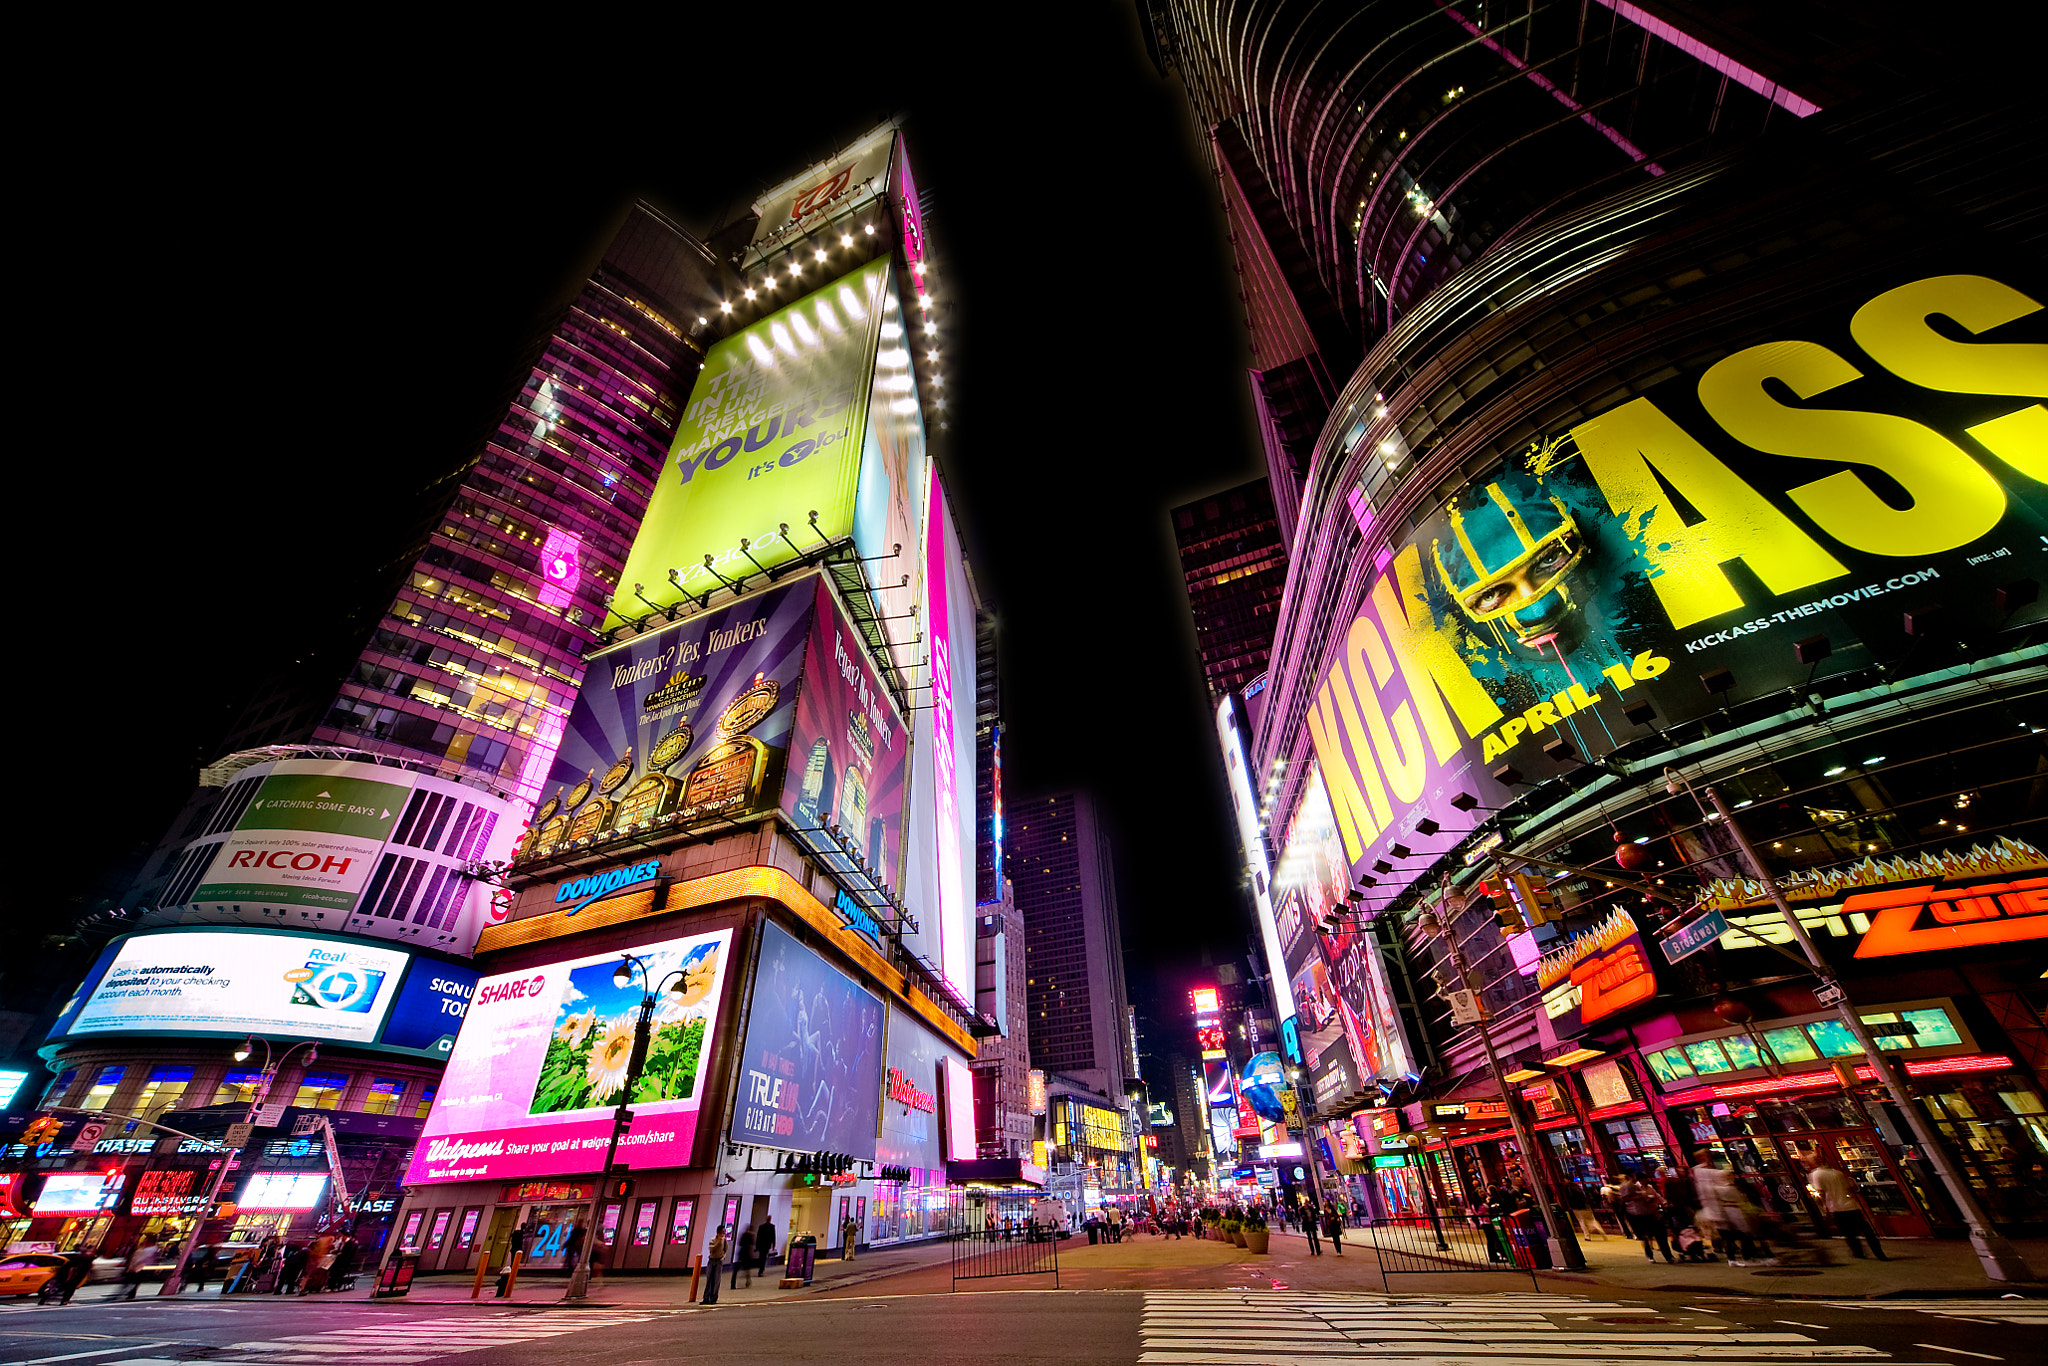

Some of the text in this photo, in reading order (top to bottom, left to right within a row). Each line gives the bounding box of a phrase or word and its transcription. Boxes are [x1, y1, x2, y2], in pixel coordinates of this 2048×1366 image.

[697, 408, 718, 429] IS
[703, 399, 763, 437] NEW
[678, 382, 855, 486] YOURS
[748, 460, 775, 480] It's
[675, 530, 786, 586] YAHOO!
[1685, 566, 1941, 654] KICKASS-THEMOVIE.COM
[610, 617, 768, 691] Yonkers? Yes, Yonkers.
[835, 630, 860, 691] Vegas?
[1308, 543, 1503, 865] KICK
[1482, 650, 1671, 765] APRIL 16
[266, 799, 376, 817] CATCHING SOME RAYS
[228, 850, 352, 875] RICOH
[1672, 920, 1718, 954] Broadway
[105, 976, 231, 989] deposited to your checking
[139, 965, 215, 976] automatically
[128, 988, 151, 998] each
[429, 977, 464, 997] SIGN
[477, 979, 529, 1006] SHARE
[749, 1069, 782, 1108] TRUE
[744, 1106, 764, 1131] 6/13
[93, 1139, 157, 1153] CHASE
[425, 1136, 505, 1167] Walgreens
[505, 1143, 530, 1155] Share
[529, 1141, 550, 1156] your
[551, 1138, 570, 1153] goal
[571, 1136, 580, 1149] at
